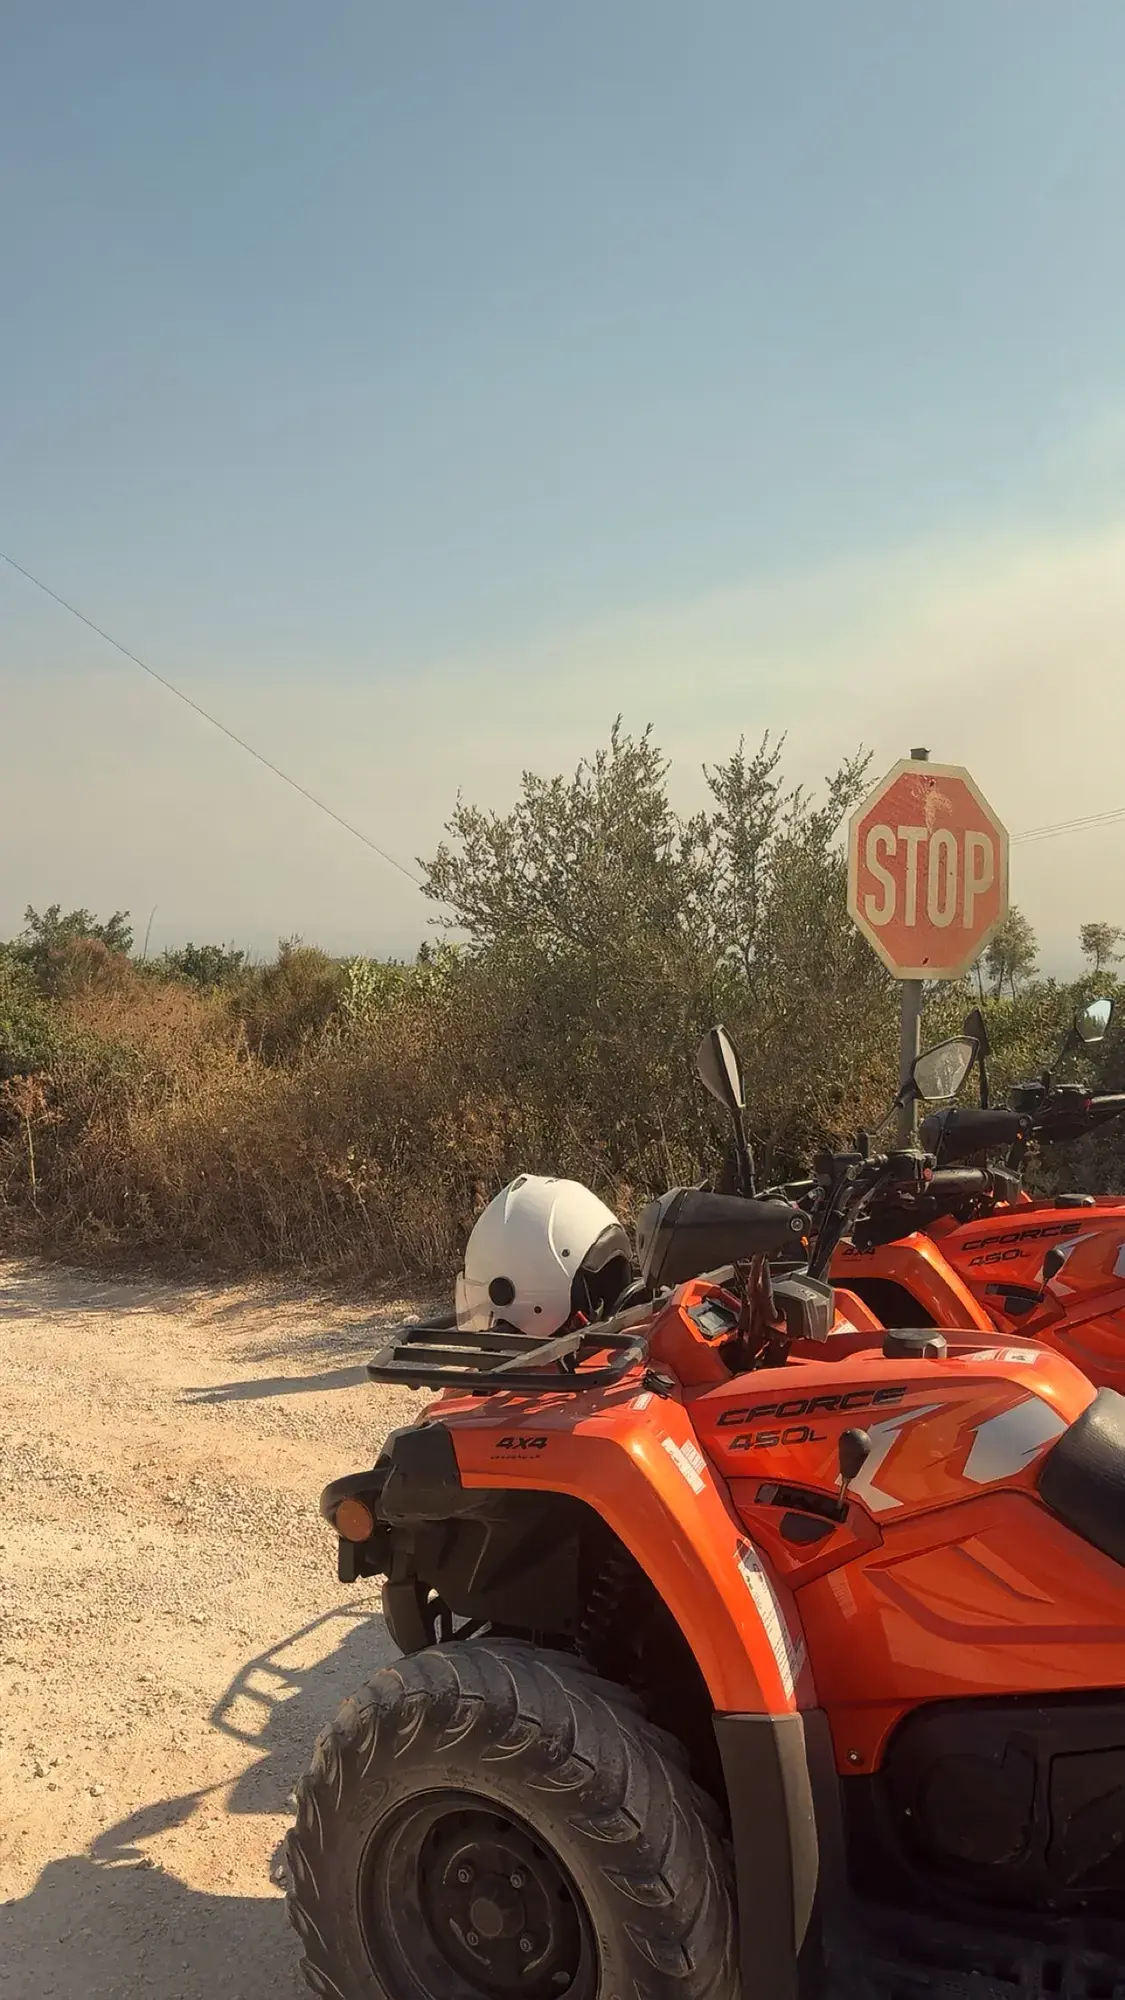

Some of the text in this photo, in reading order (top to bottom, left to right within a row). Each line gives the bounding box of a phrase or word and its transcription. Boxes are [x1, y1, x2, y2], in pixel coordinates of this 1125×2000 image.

[864, 824, 994, 929] STOP
[961, 1222, 1082, 1251] CFORCE
[968, 1249, 1031, 1267] 450L
[716, 1386, 907, 1426] CFORCE
[728, 1425, 827, 1451] 450L
